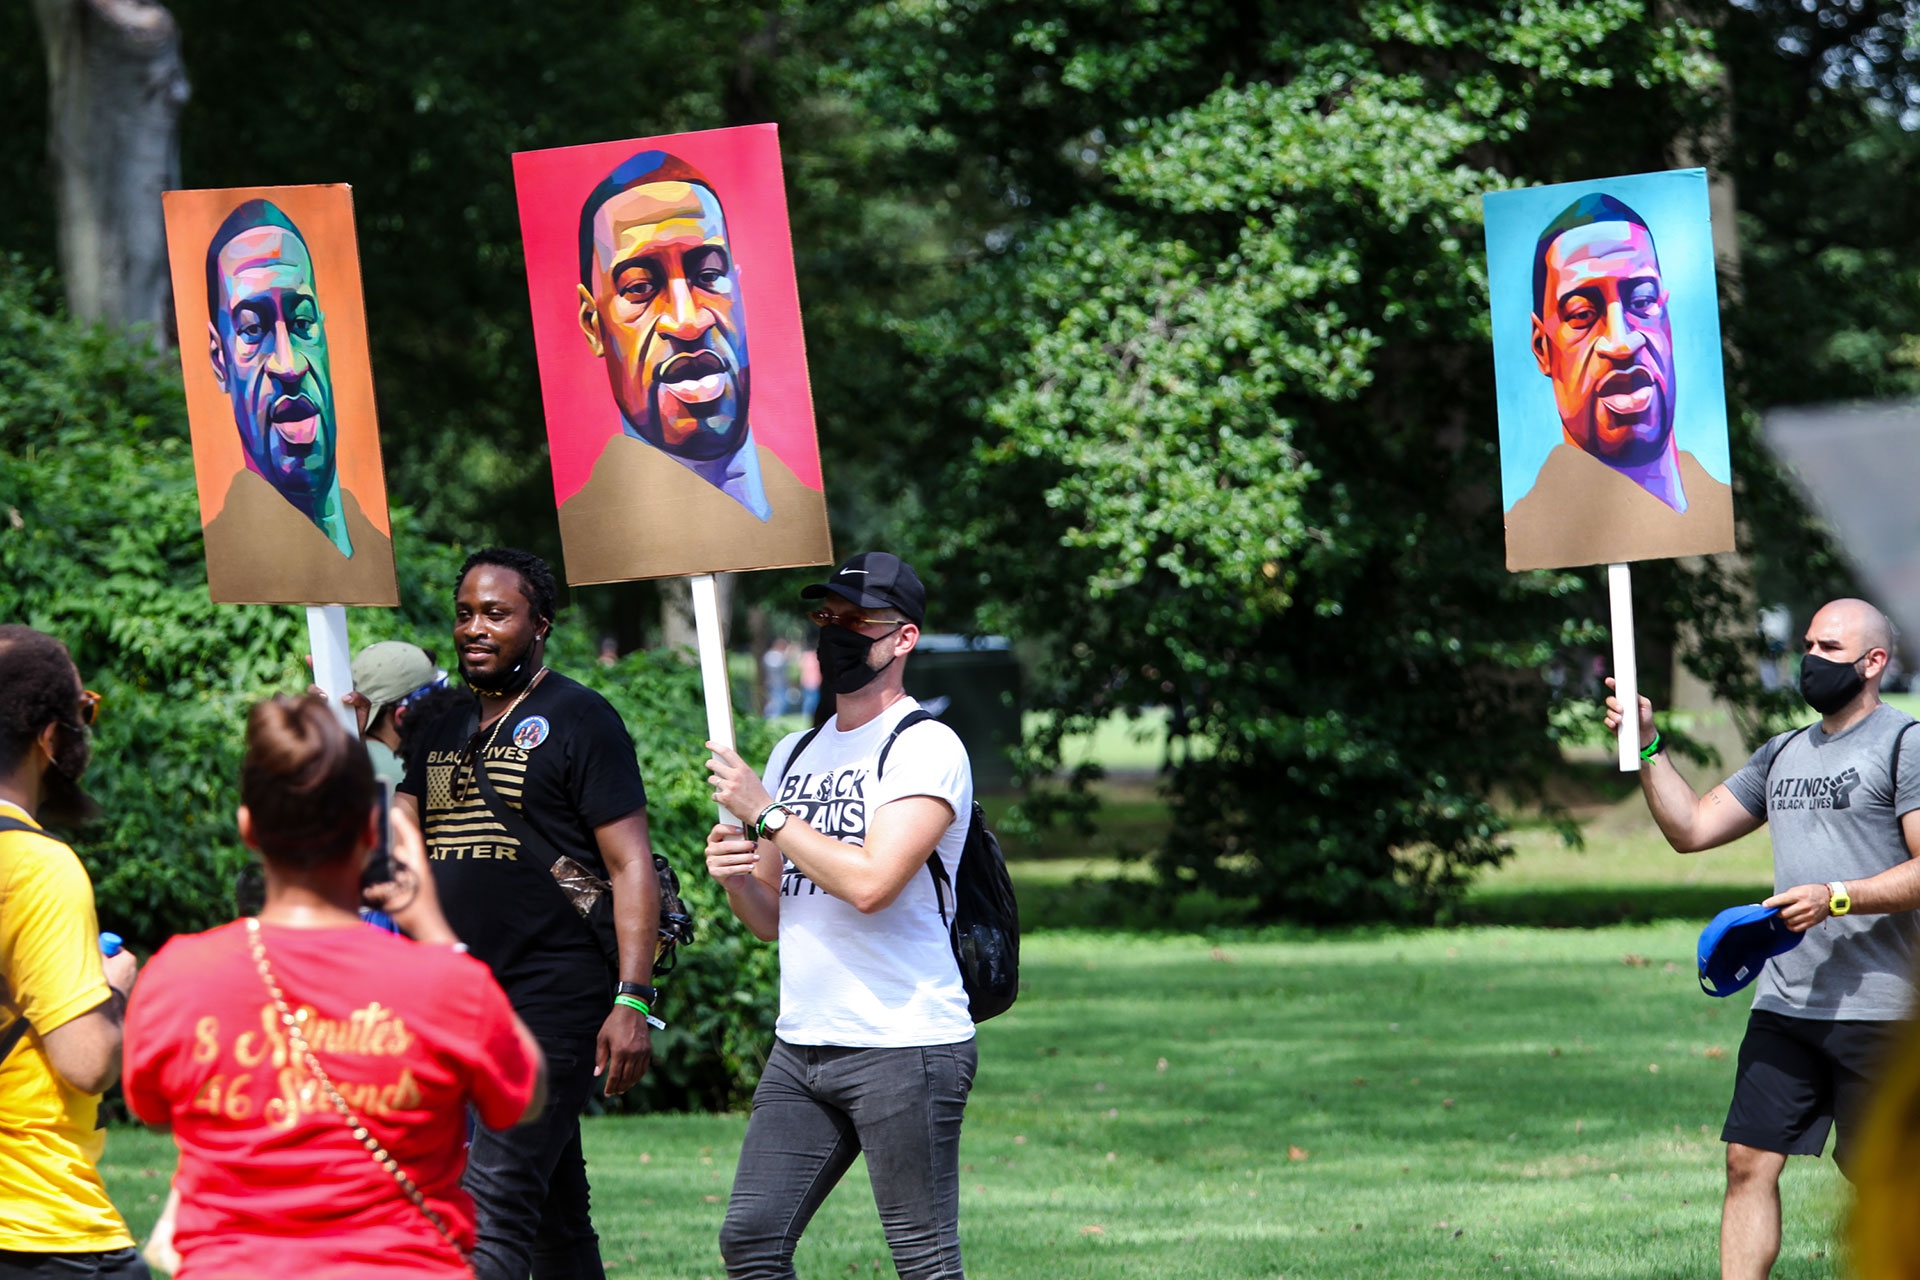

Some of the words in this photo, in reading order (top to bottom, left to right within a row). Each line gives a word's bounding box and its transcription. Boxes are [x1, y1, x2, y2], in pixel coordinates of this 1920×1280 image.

[482, 746, 529, 762] IVES
[1777, 799, 1805, 811] BLACK
[1809, 797, 1831, 811] LIVES
[785, 801, 865, 834] RANS
[429, 845, 518, 861] ATTER
[194, 1016, 219, 1064] 8
[194, 1073, 253, 1121] 46
